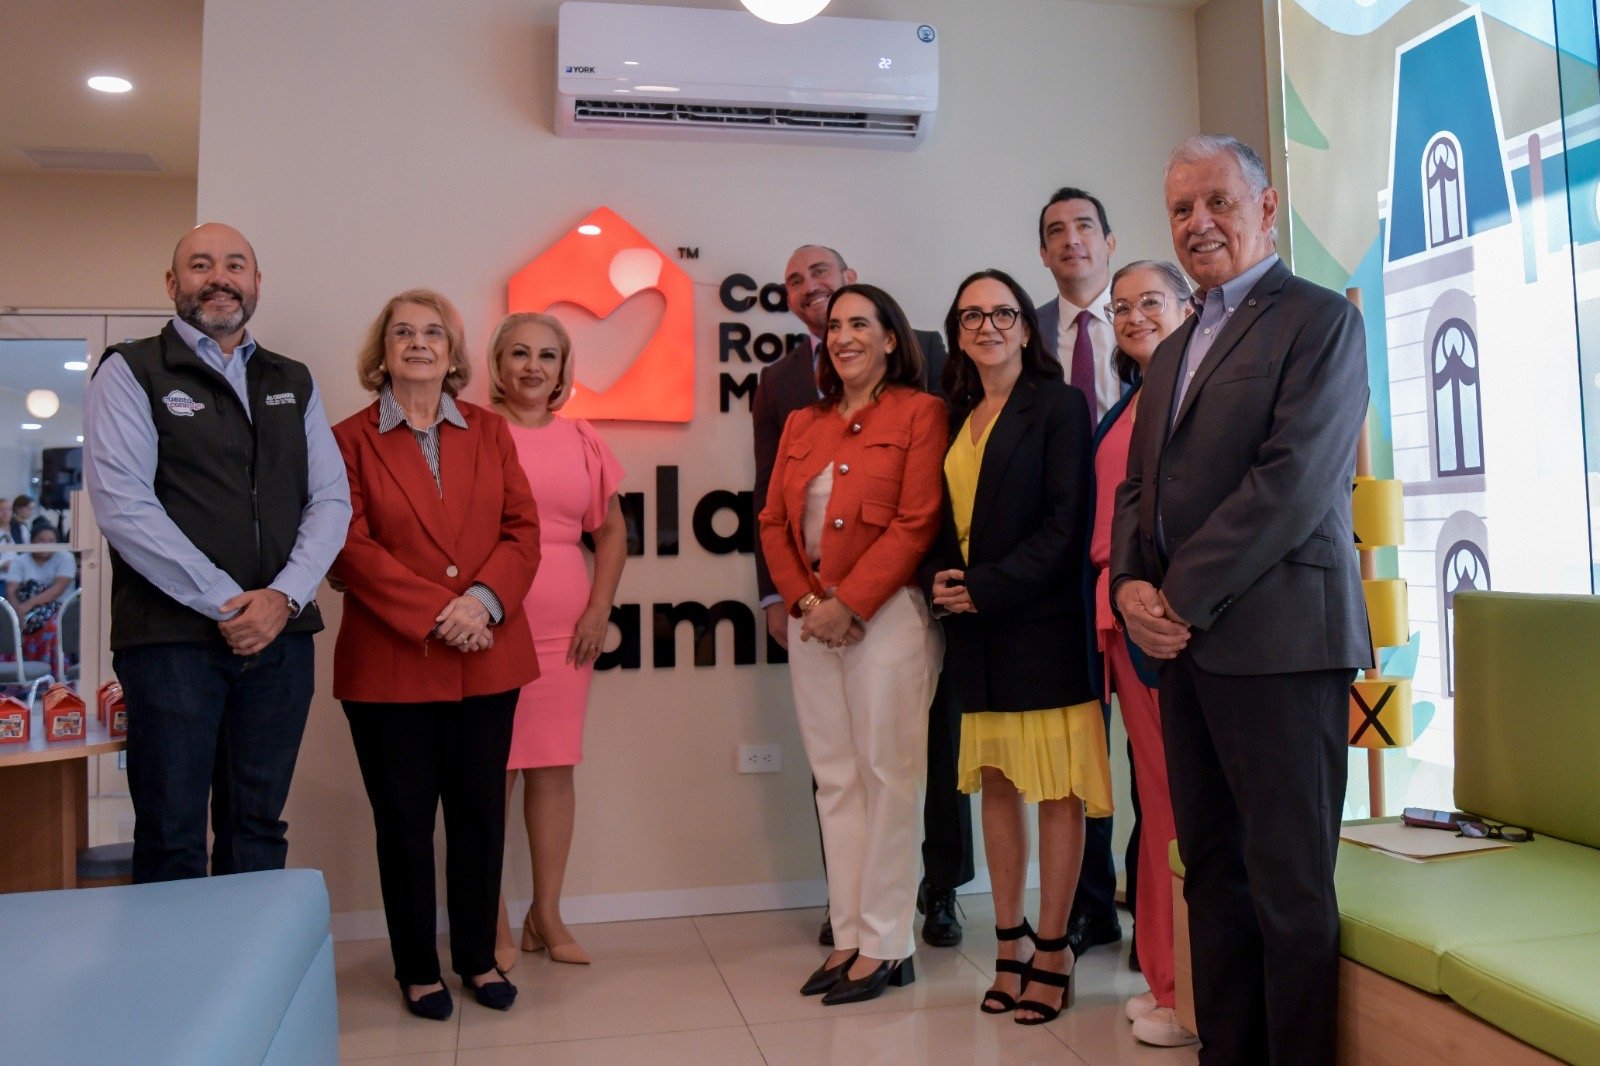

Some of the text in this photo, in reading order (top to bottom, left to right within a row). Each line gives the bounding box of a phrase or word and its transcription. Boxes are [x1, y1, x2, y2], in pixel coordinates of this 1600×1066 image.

[573, 66, 596, 74] YORK
[678, 247, 700, 259] TM
[719, 273, 790, 313] Ca
[719, 322, 809, 364] Ron
[719, 373, 759, 413] M
[581, 465, 755, 556] ala
